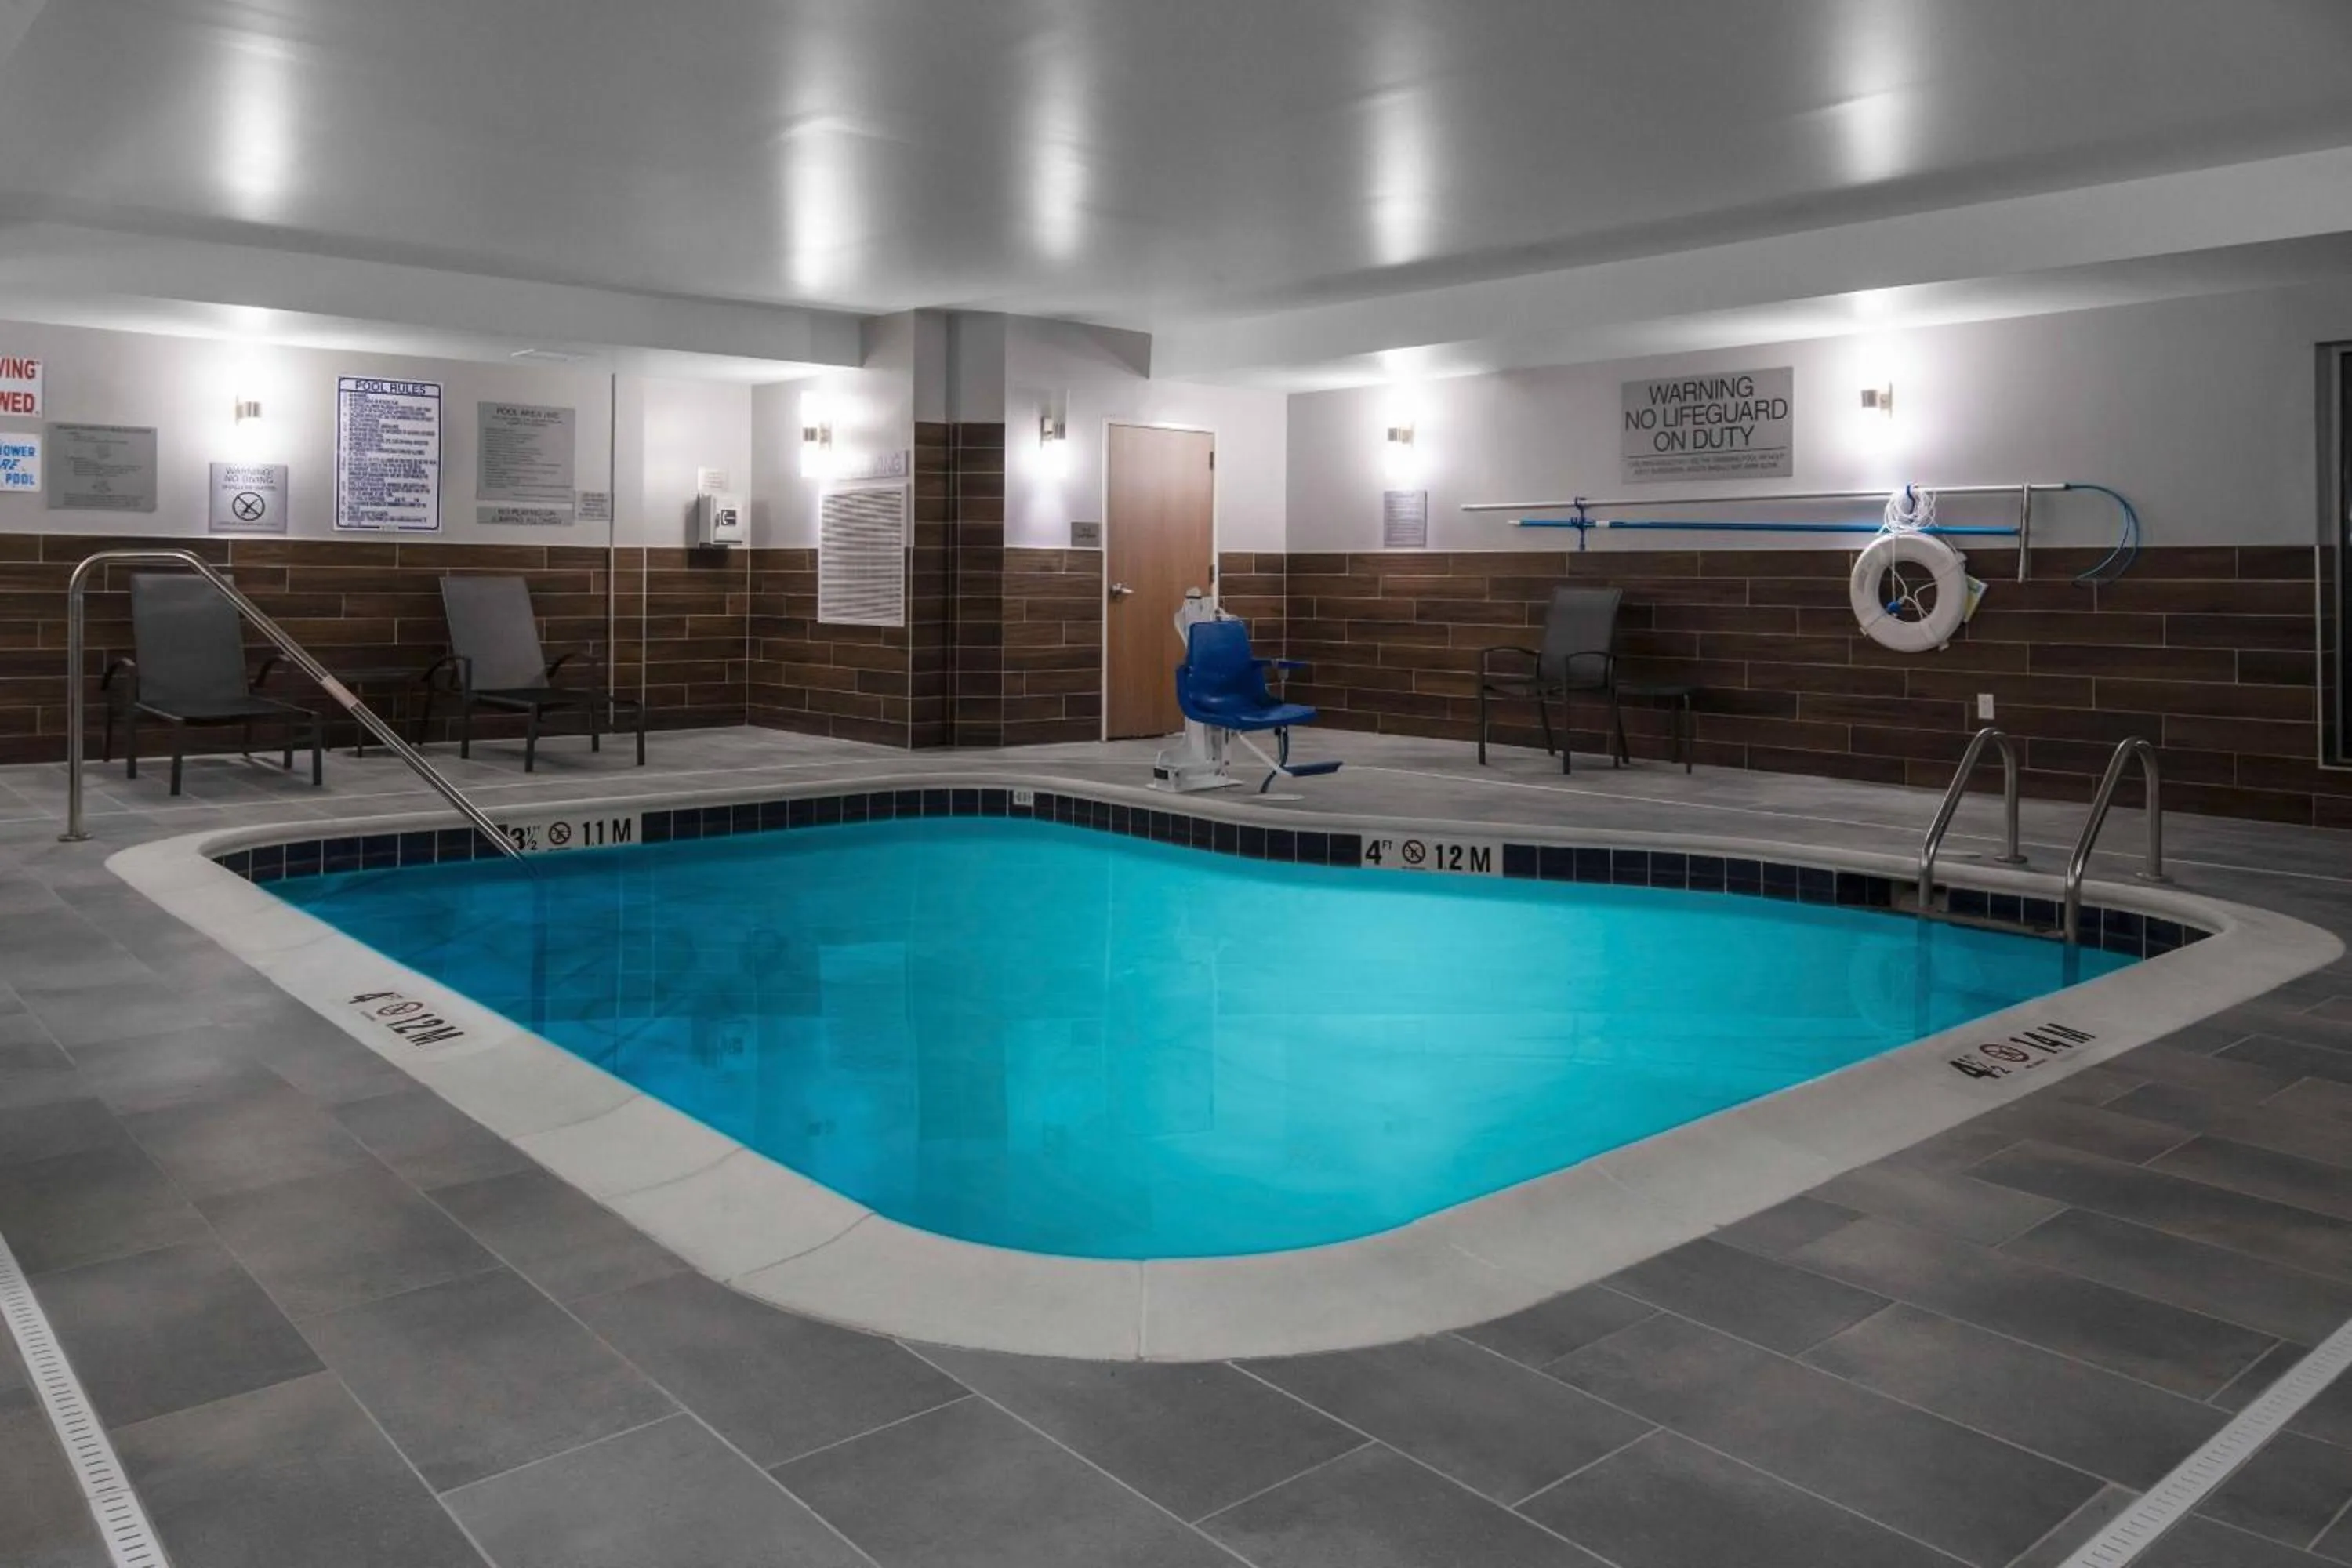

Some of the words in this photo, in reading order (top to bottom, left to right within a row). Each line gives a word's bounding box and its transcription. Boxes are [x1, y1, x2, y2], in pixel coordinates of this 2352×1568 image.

[354, 379, 387, 392] POOL
[390, 382, 426, 395] RULES
[1649, 376, 1755, 405] WARNING
[1625, 408, 1657, 430] NO
[1663, 398, 1788, 427] LIFEGUARD
[1653, 430, 1686, 452] ON
[1693, 425, 1755, 449] DUTY
[5, 473, 35, 485] POOL
